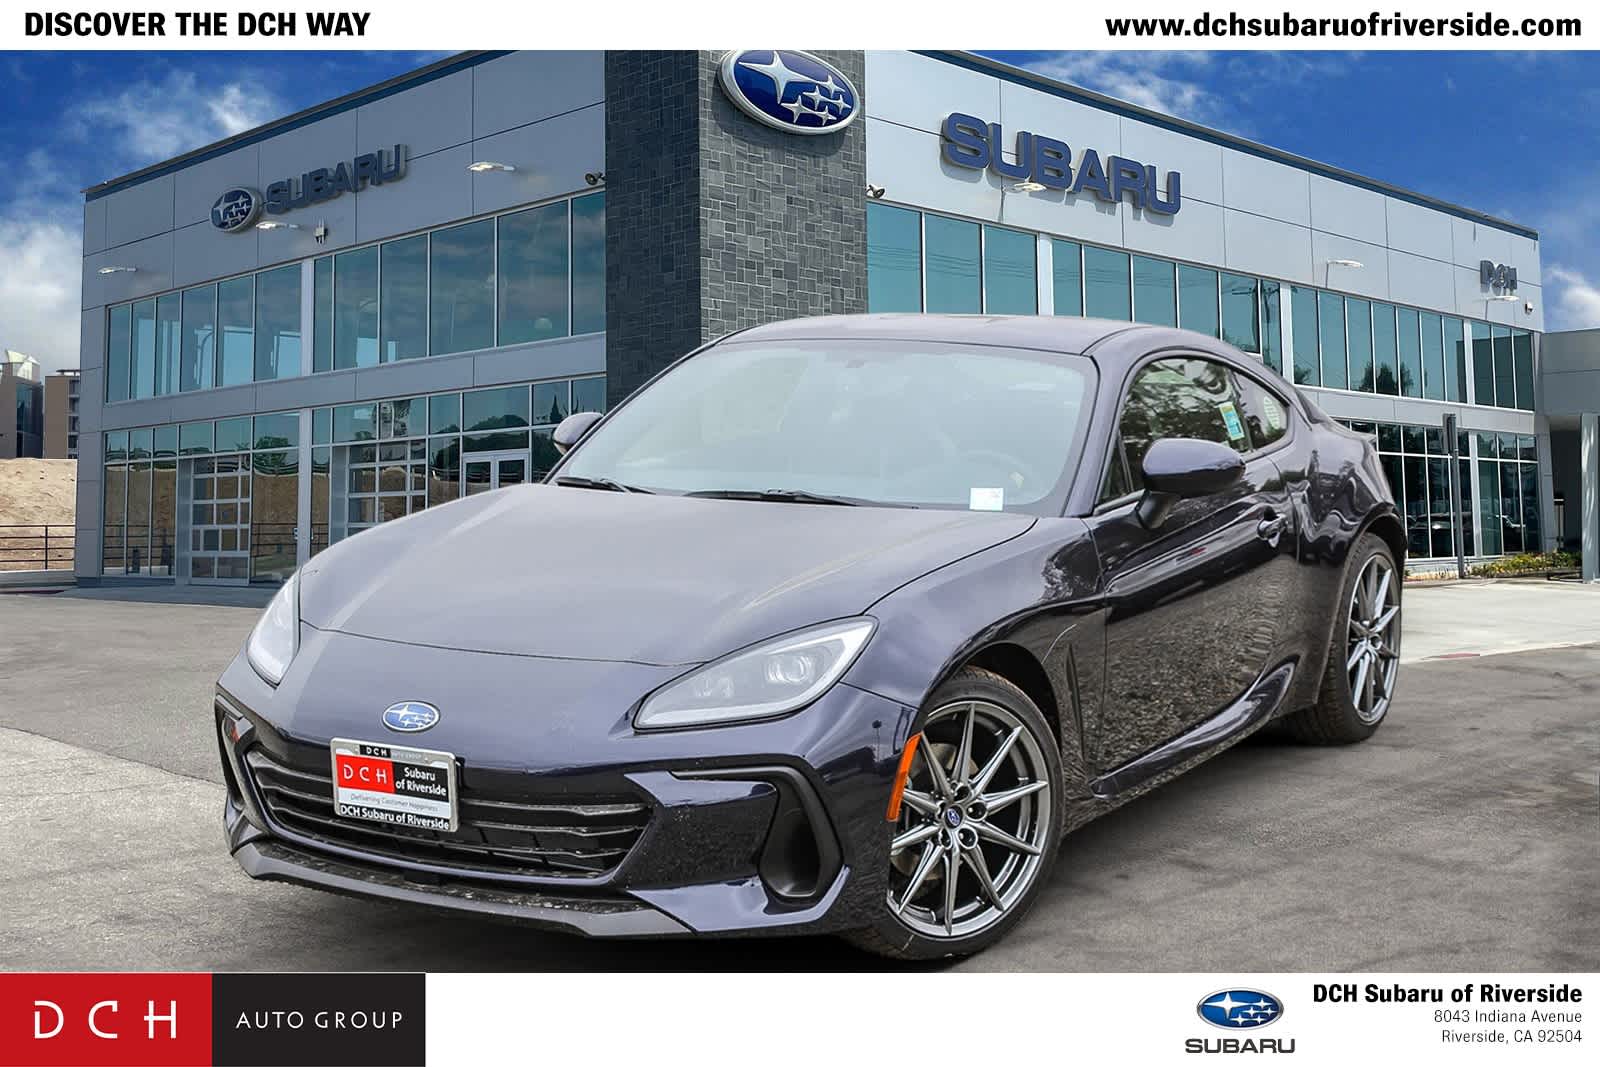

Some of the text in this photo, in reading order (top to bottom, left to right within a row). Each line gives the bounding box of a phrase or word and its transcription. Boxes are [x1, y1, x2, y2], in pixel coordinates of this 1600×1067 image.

[940, 111, 1182, 216] SUBARU
[266, 144, 407, 215] SUBARU
[404, 766, 436, 781] Subaru
[395, 780, 447, 797] of Riverside
[340, 804, 449, 831] DCH Subaru of Riverside
